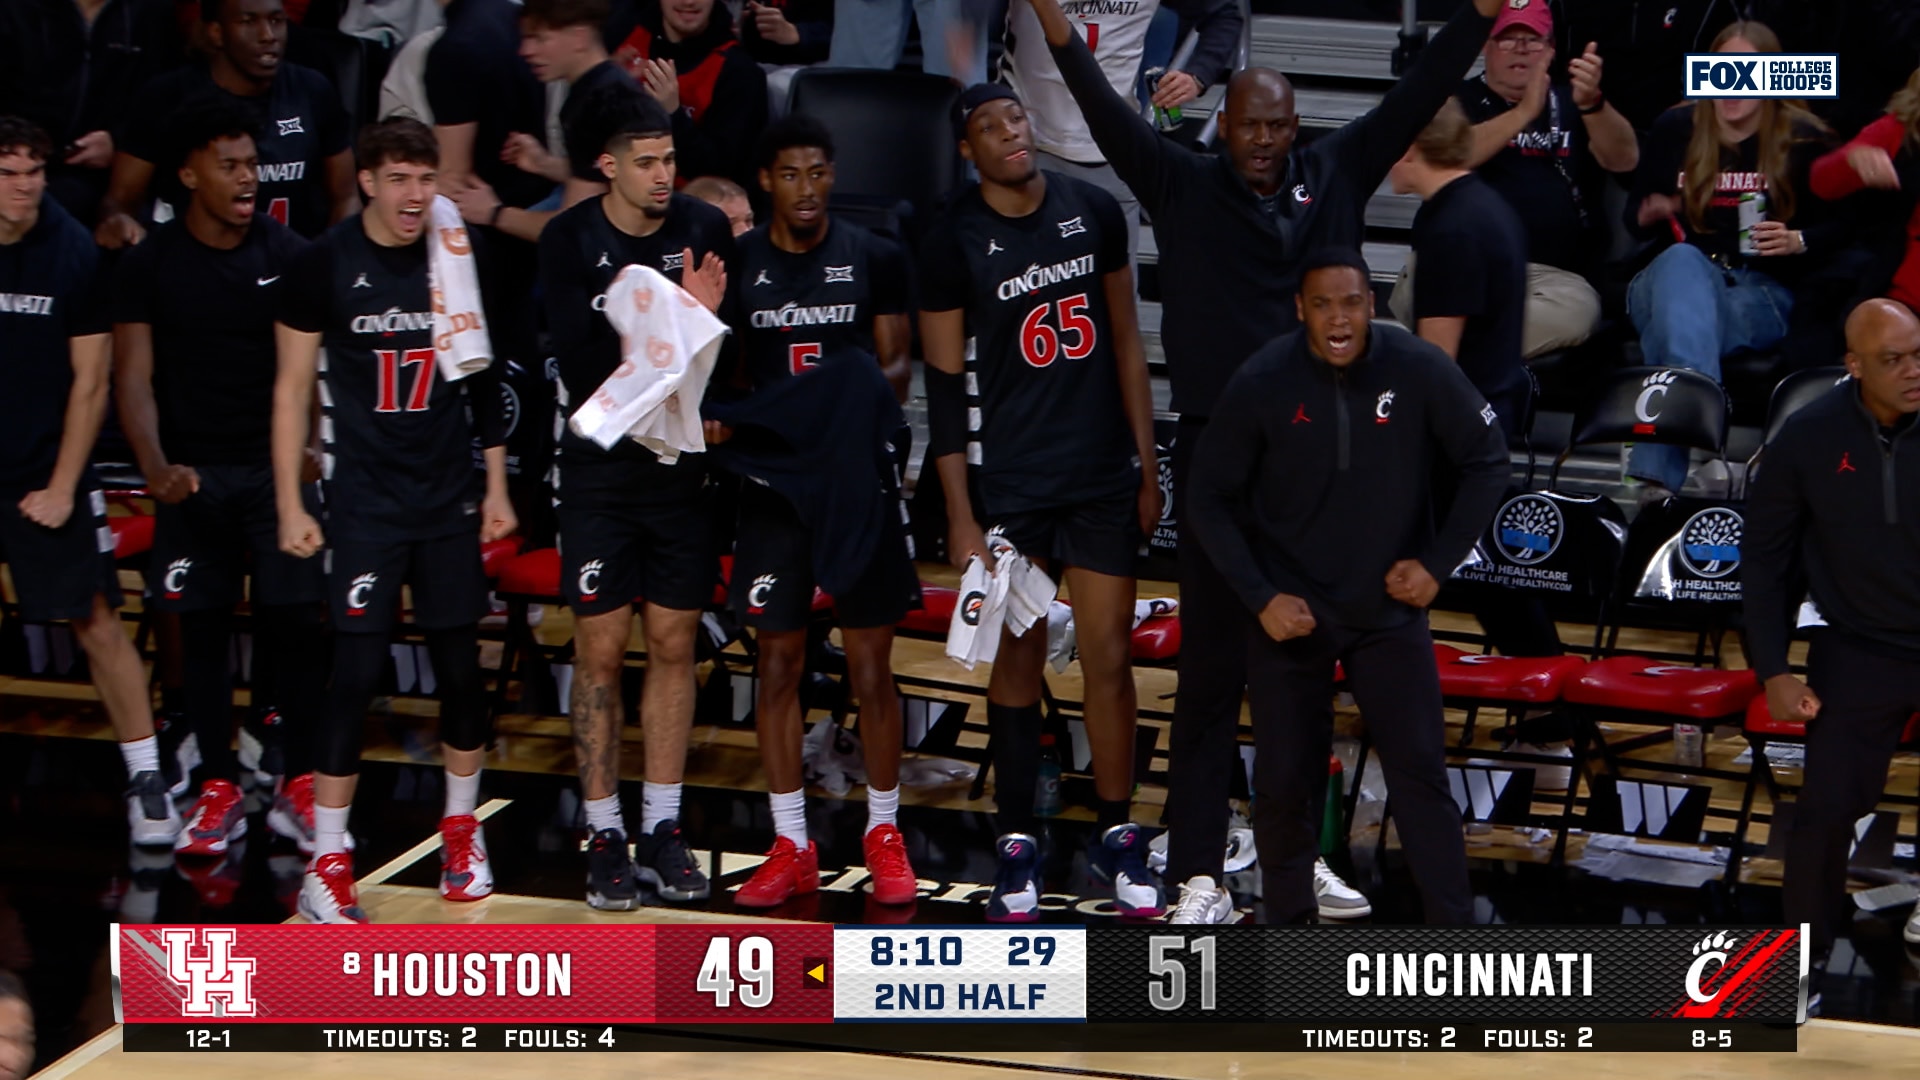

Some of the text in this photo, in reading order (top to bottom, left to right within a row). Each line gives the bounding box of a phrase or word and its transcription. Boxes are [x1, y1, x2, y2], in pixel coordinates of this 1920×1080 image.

[997, 254, 1095, 301] CINCINNATI
[750, 301, 857, 332] CINCINNATI
[1019, 292, 1097, 368] 65
[372, 347, 437, 413] 17
[1464, 571, 1573, 592] LIVE LIFE HEALTHY.COM
[1498, 564, 1568, 582] HEALTHCARE
[1685, 579, 1742, 591] HEALTHCA
[1676, 590, 1697, 599] LIFE
[1699, 591, 1743, 601] HEALTHY
